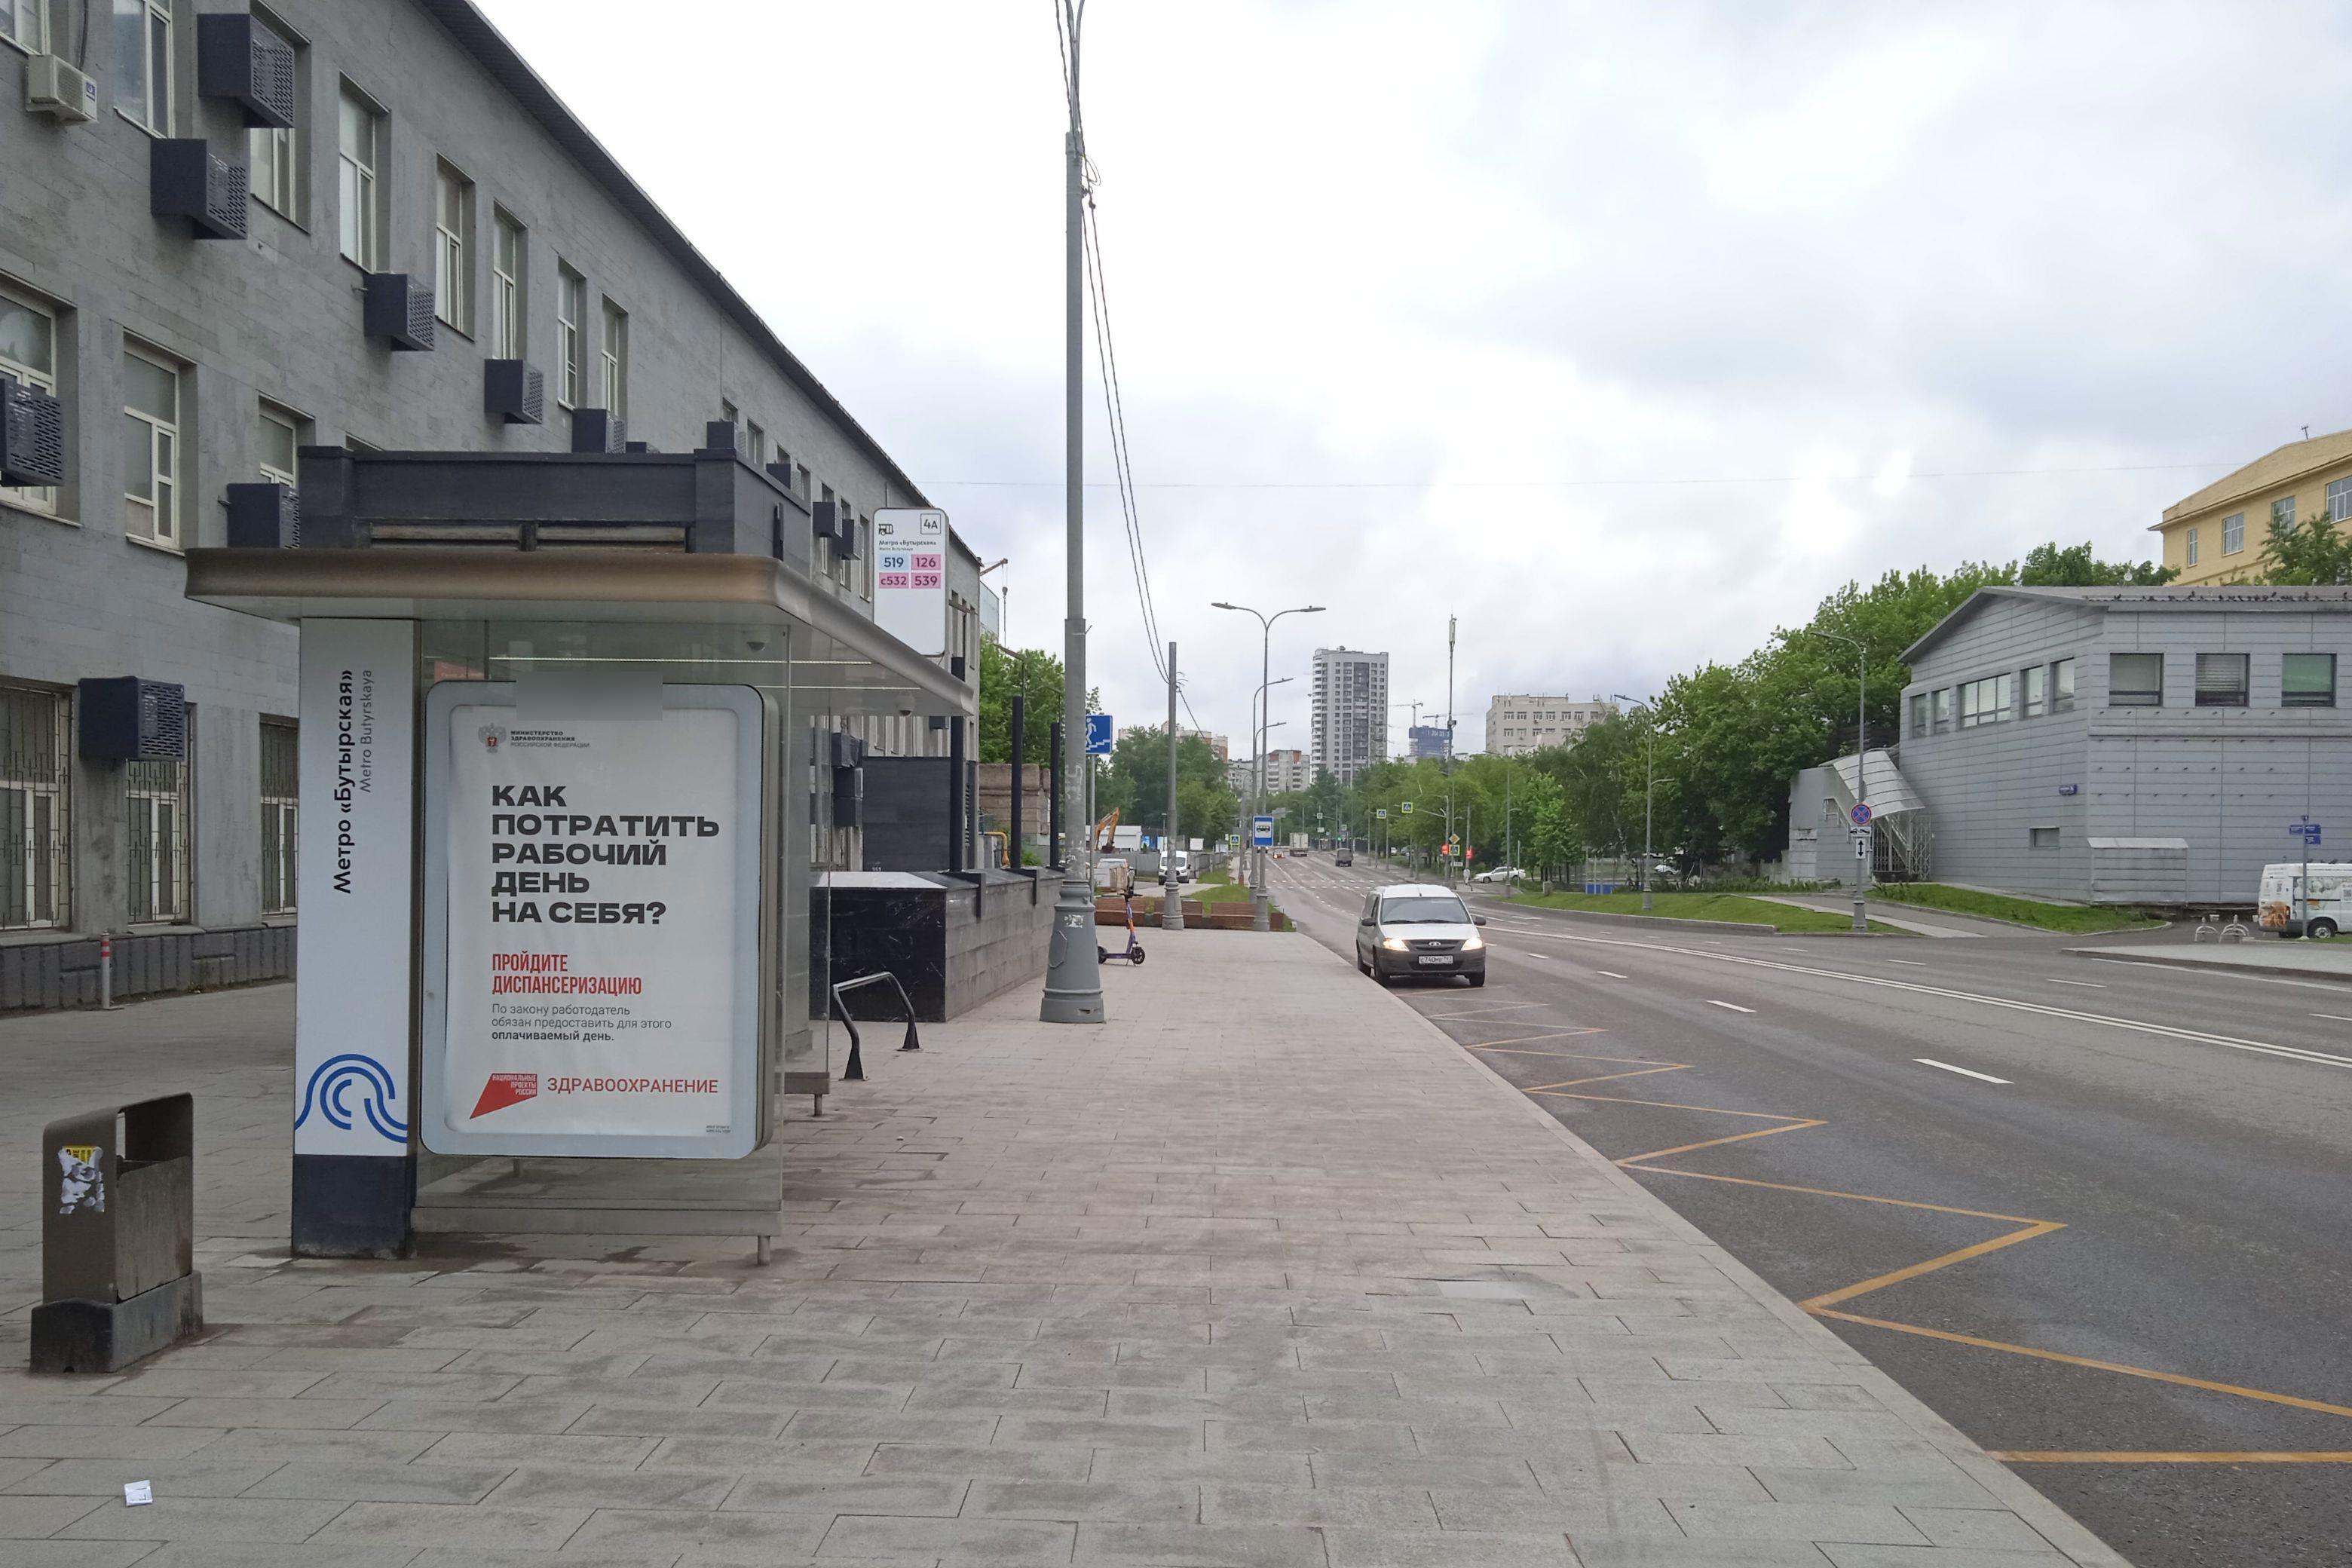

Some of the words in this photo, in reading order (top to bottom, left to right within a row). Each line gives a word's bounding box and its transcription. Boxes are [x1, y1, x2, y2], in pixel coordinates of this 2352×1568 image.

[884, 557, 904, 568] 519
[916, 557, 936, 568] 126
[914, 575, 938, 586] 539
[360, 669, 375, 745] Butyrskaya
[334, 669, 355, 813] «Бутырская»
[360, 749, 372, 793] Metro
[492, 785, 567, 807] КАК
[492, 813, 720, 837] ПОТРАТИТЬ
[333, 819, 355, 894] Метро
[492, 838, 666, 865] РАБОЧИЙ
[491, 871, 590, 897] ДЕНЬ
[492, 902, 543, 923] НА
[548, 901, 667, 925] СЕБЯ?
[492, 951, 568, 974] ПРОЙДИТЕ
[492, 975, 642, 997] ДИСПАНСЕРИЗАЦИЮ
[492, 1003, 507, 1014] По
[510, 1005, 550, 1016] закону
[552, 1004, 630, 1017] работодатель
[492, 1017, 531, 1027] обязан
[534, 1019, 614, 1030] предоставить
[617, 1019, 638, 1030] для
[641, 1019, 672, 1029] этого
[492, 1030, 580, 1041] оплачиваемый
[583, 1033, 614, 1043] день.
[547, 1078, 718, 1094] ЗДРАВООХРАНЕНИЕ
